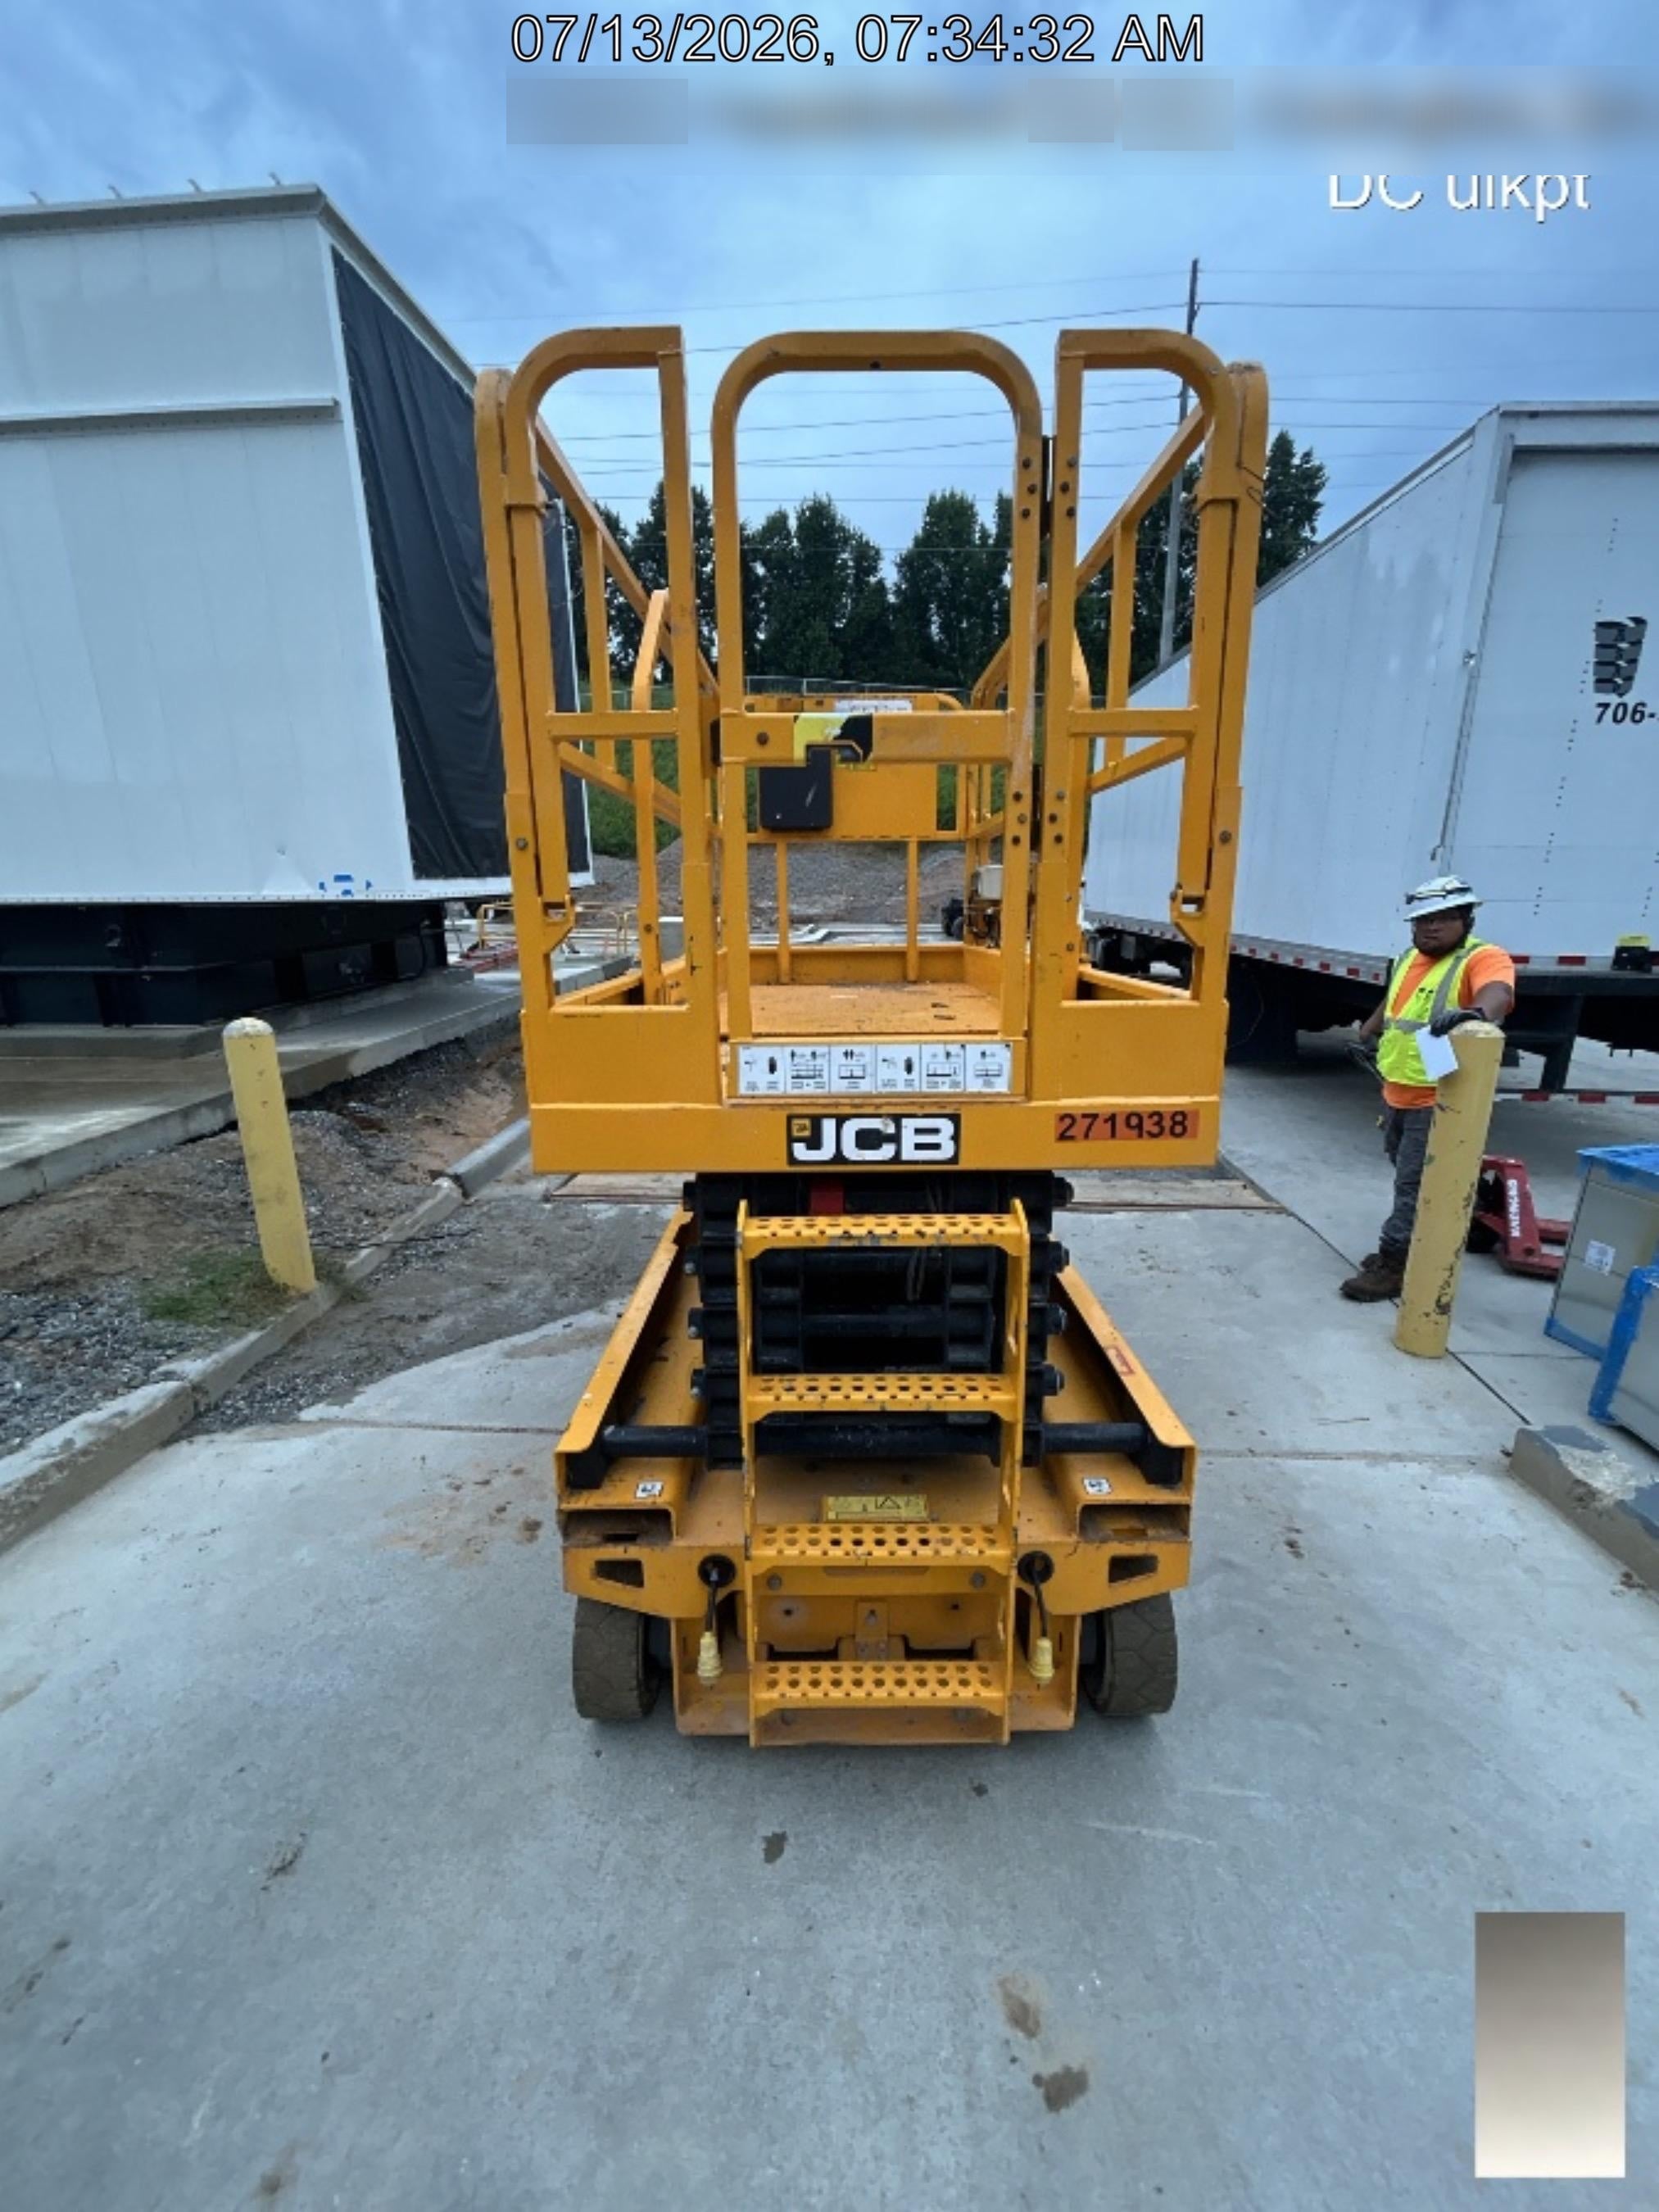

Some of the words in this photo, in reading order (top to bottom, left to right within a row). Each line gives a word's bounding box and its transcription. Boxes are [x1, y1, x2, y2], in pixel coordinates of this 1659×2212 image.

[1594, 701, 1659, 725] 706-
[790, 1117, 955, 1162] JCB
[1056, 1110, 1189, 1142] 271938
